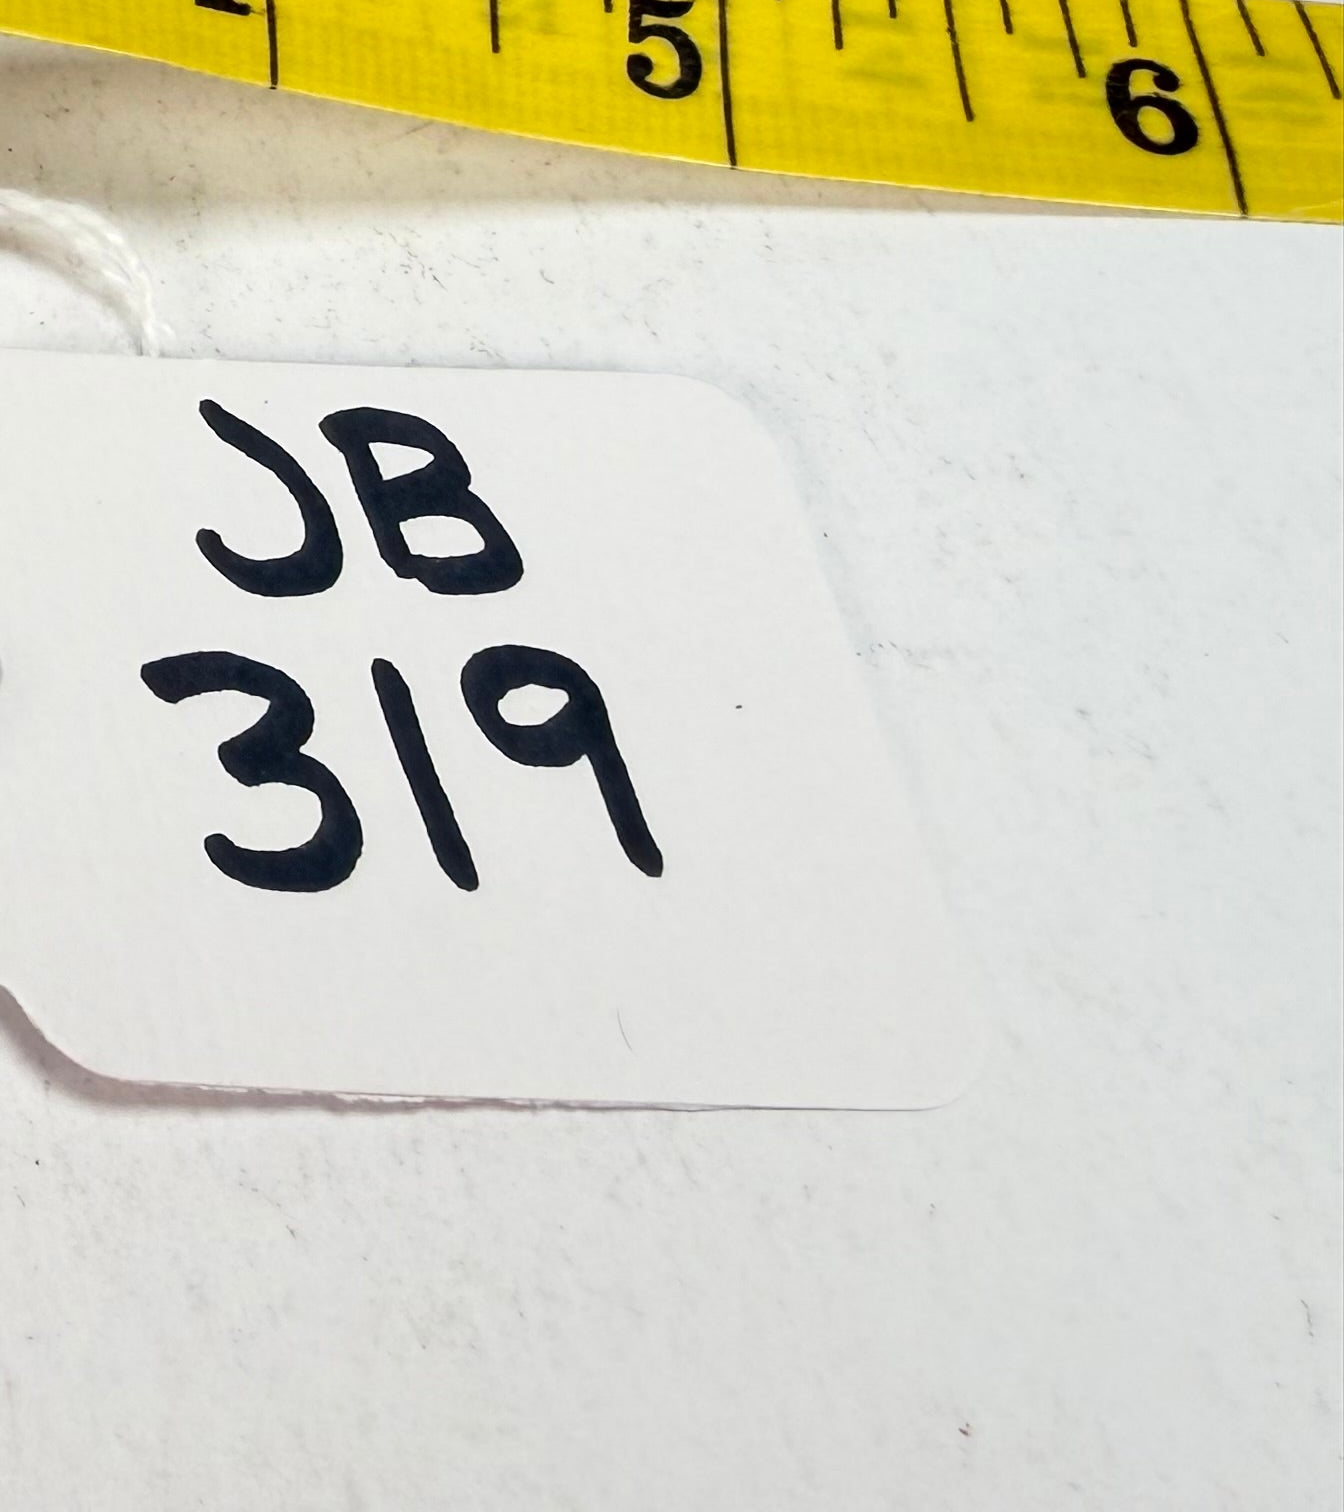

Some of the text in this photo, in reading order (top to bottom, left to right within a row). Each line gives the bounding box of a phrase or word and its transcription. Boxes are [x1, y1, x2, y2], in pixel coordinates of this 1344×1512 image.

[1104, 57, 1200, 156] 6
[195, 398, 525, 598] JB
[139, 643, 665, 893] 319
